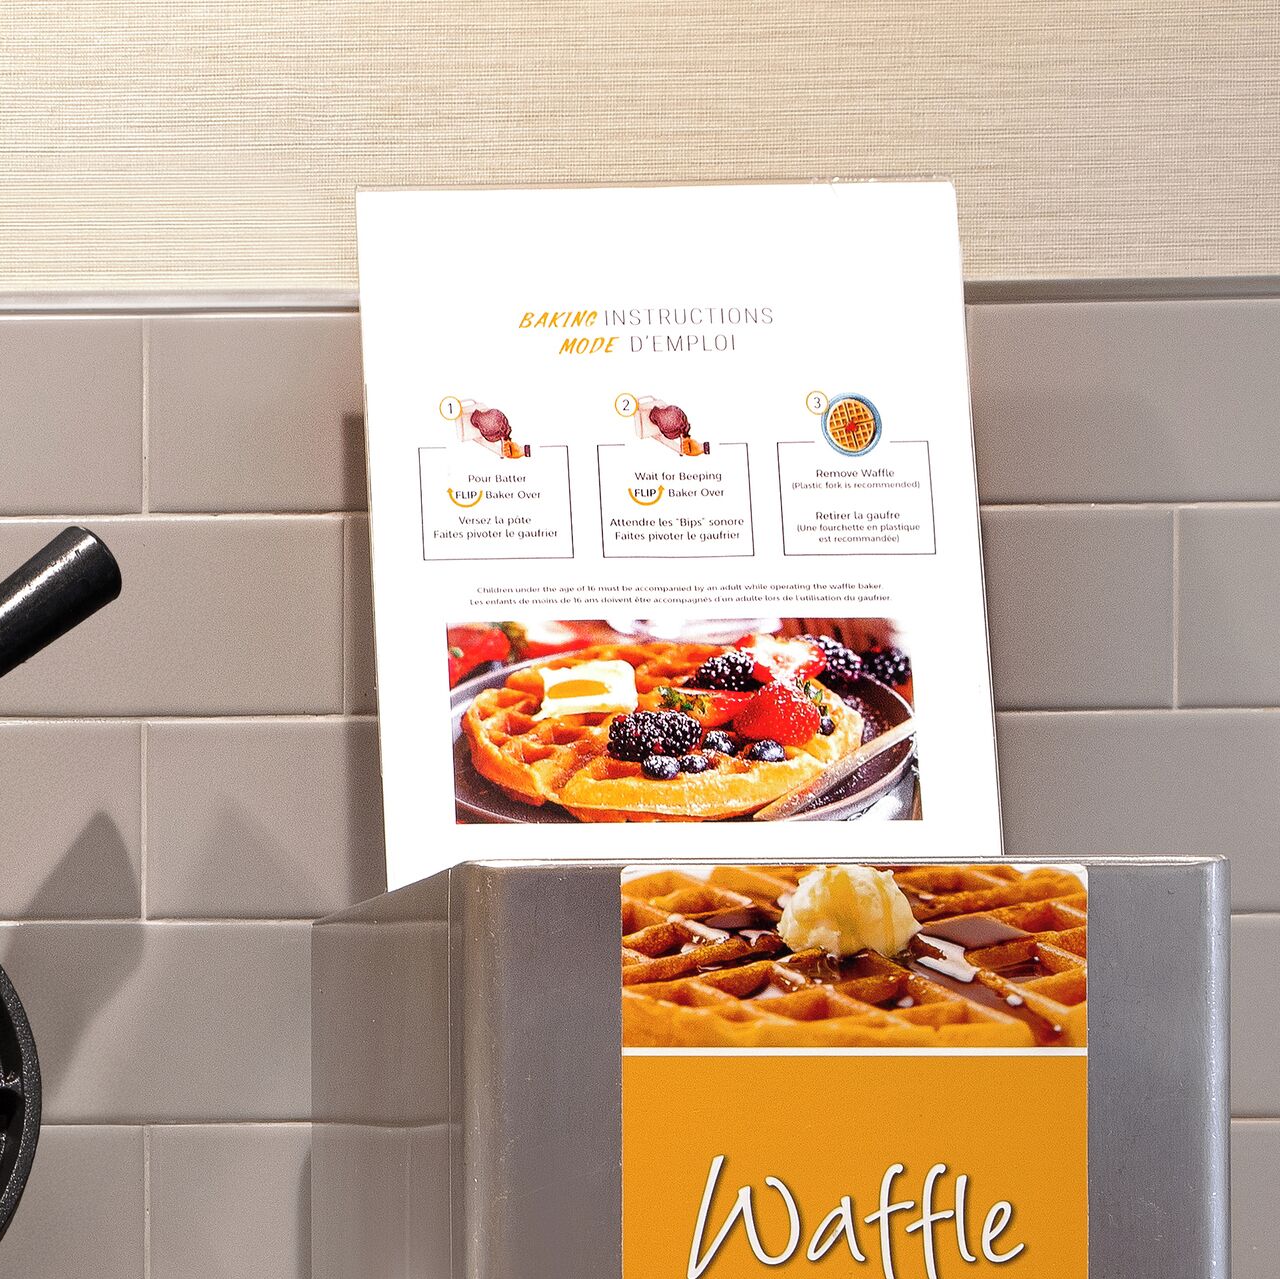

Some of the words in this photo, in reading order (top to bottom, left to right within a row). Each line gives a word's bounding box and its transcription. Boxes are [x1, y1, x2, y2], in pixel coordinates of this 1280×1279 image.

[519, 309, 598, 328] BAKING
[604, 307, 774, 326] INSTRUCTIONS
[558, 336, 620, 354] MODE
[630, 334, 736, 352] D'EMPLOI
[622, 399, 630, 411] 2
[813, 396, 822, 409] 3
[448, 402, 453, 414] 1
[634, 472, 658, 480] Wait
[662, 472, 675, 480] for
[679, 472, 722, 482] Beeping
[816, 469, 858, 478] Remove
[861, 468, 895, 477] Waffle
[468, 474, 491, 483] Pour
[495, 474, 526, 483] Batter
[791, 482, 822, 490] (Plastic
[825, 481, 842, 489] fork
[853, 480, 921, 488] recommended)
[455, 490, 477, 499] FLIP
[485, 490, 514, 499] Baker
[518, 490, 541, 499] Over
[634, 488, 656, 497] FLIP
[668, 488, 697, 497] Baker
[701, 488, 724, 497] Over
[458, 516, 491, 525] Versez
[495, 515, 504, 524] la
[815, 511, 850, 520] Retirer
[854, 511, 864, 520] la
[866, 510, 900, 521] gaufre
[609, 518, 655, 527] Attendre
[659, 518, 673, 527] les
[709, 518, 744, 526] sonore
[797, 524, 817, 532] (Une
[819, 524, 864, 532] fourchette
[880, 523, 920, 532] plastique
[433, 530, 463, 539] Faites
[467, 529, 501, 540] pivoter
[505, 529, 515, 538] le
[518, 529, 557, 540] gaufrier
[615, 531, 645, 541] Faites
[648, 531, 683, 542] pivoter
[687, 531, 696, 540] le
[699, 530, 740, 542] gaufrier
[818, 535, 831, 543] est
[635, 585, 692, 593] accompanied
[770, 583, 810, 591] operating
